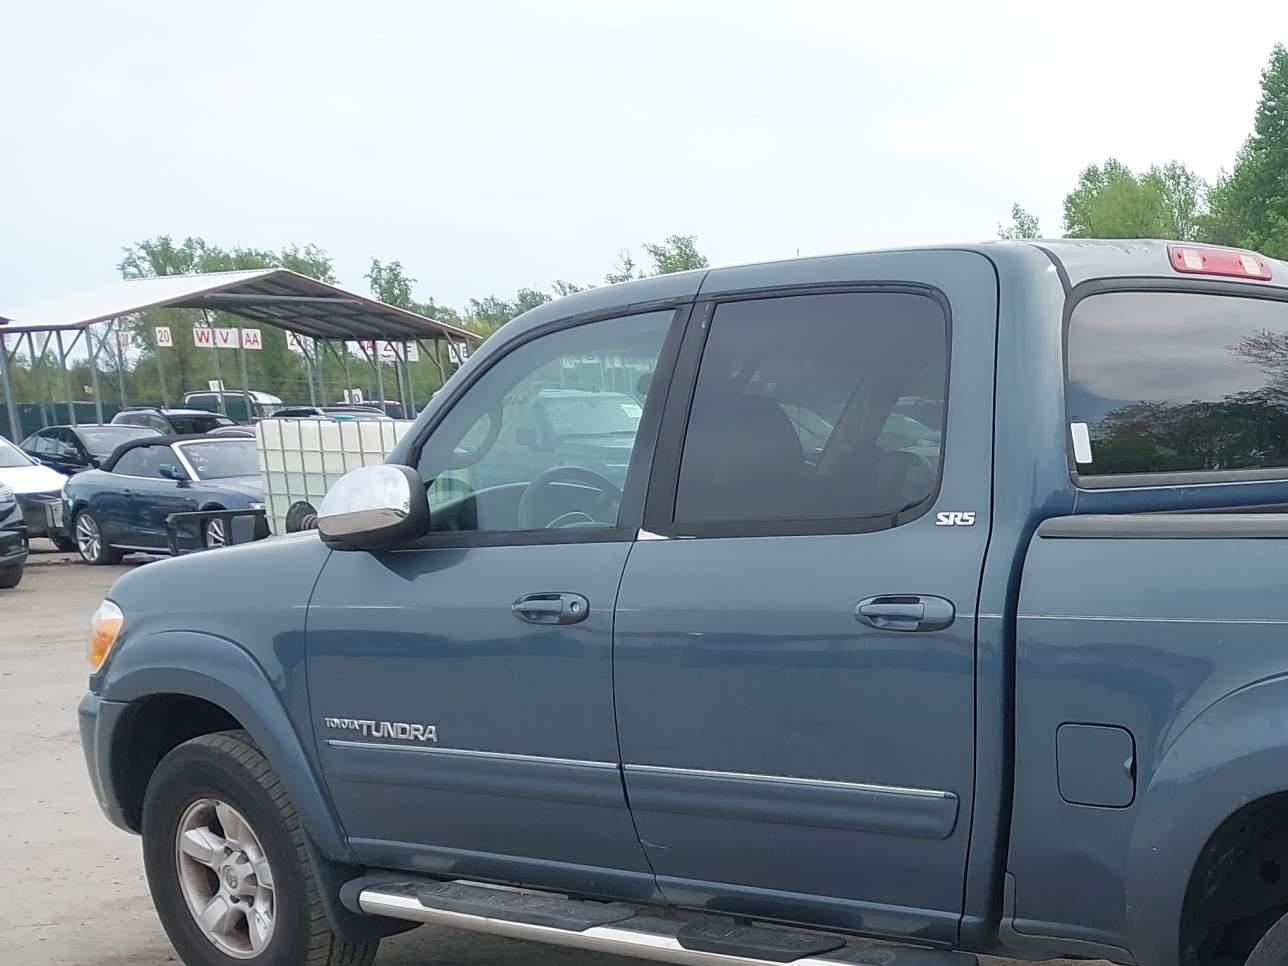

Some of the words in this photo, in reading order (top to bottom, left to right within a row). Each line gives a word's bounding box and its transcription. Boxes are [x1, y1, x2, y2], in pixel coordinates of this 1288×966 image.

[157, 331, 170, 343] 20
[195, 330, 210, 343] W
[219, 331, 230, 344] V
[244, 334, 260, 345] AA
[936, 512, 976, 526] SR5
[324, 717, 359, 730] TOYOTA
[359, 719, 439, 743] TUNDRA
